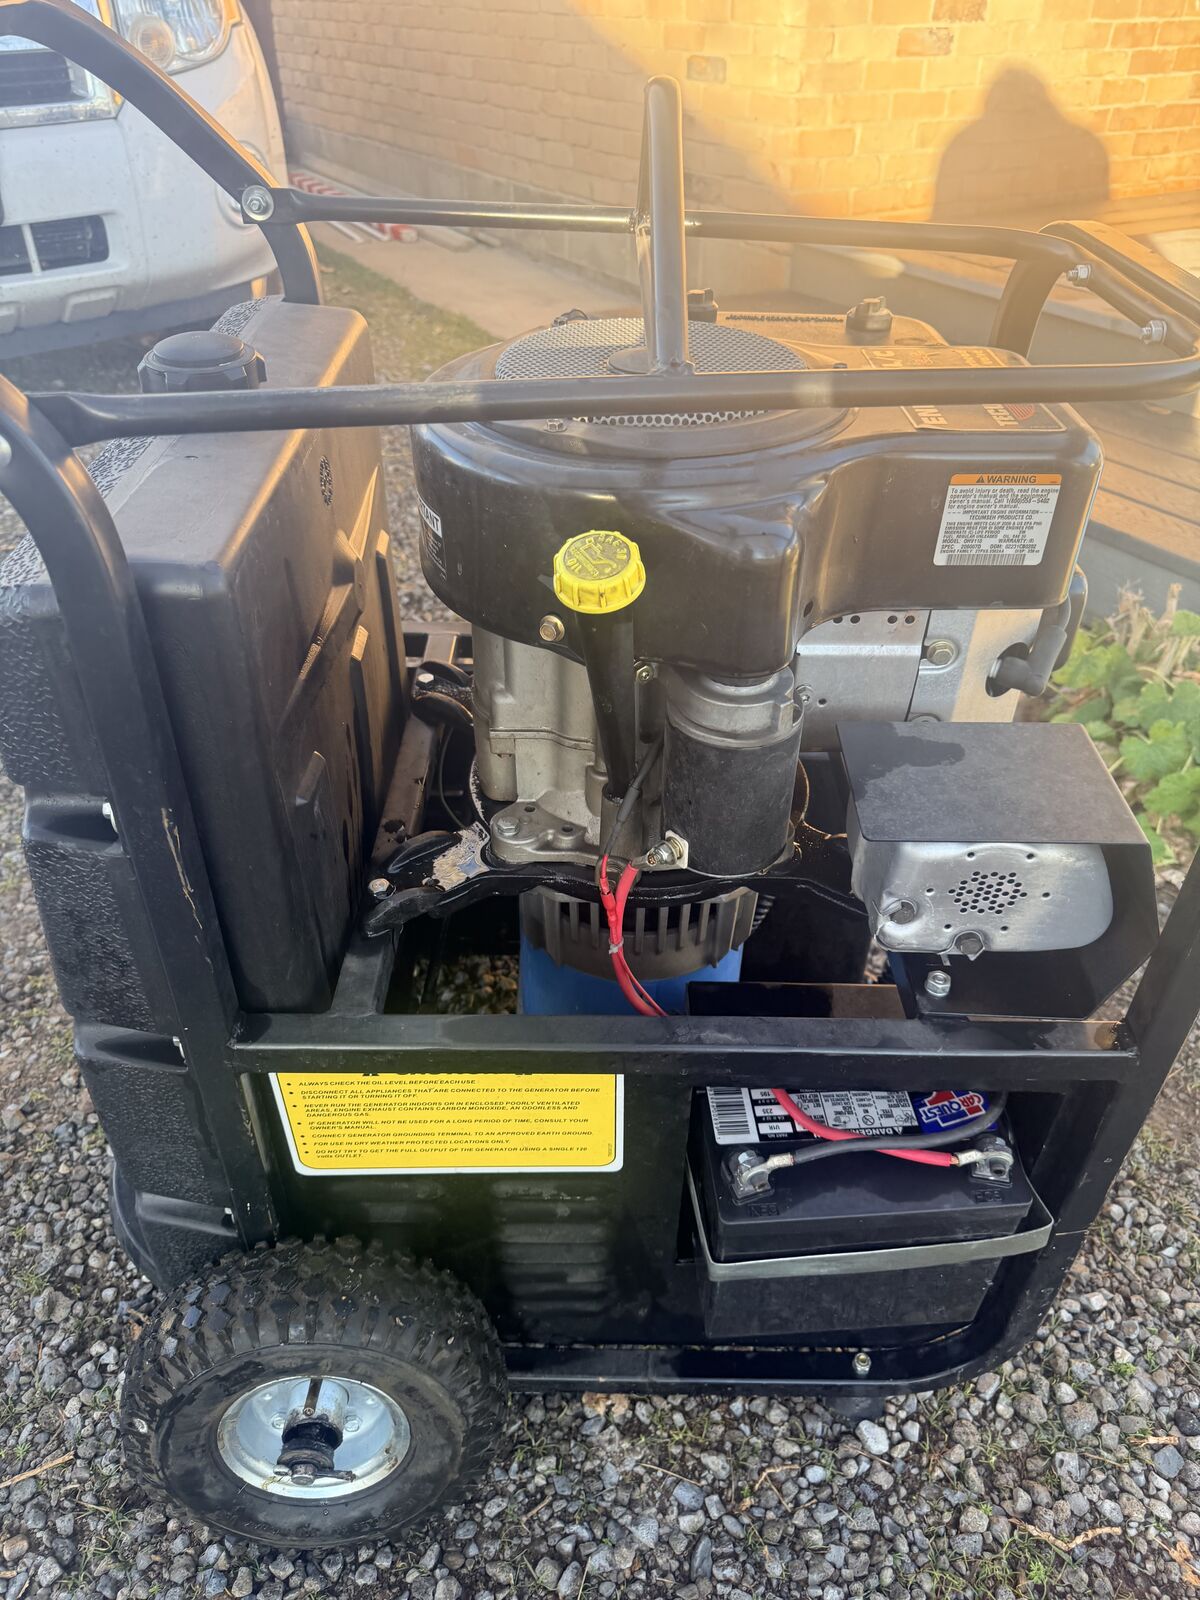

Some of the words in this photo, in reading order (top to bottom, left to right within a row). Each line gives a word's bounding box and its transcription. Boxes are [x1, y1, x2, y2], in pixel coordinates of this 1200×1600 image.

[987, 475, 1037, 483] WARNING
[567, 558, 582, 574] OIL
[960, 1094, 983, 1107] CAR
[921, 1101, 962, 1119] QUEST
